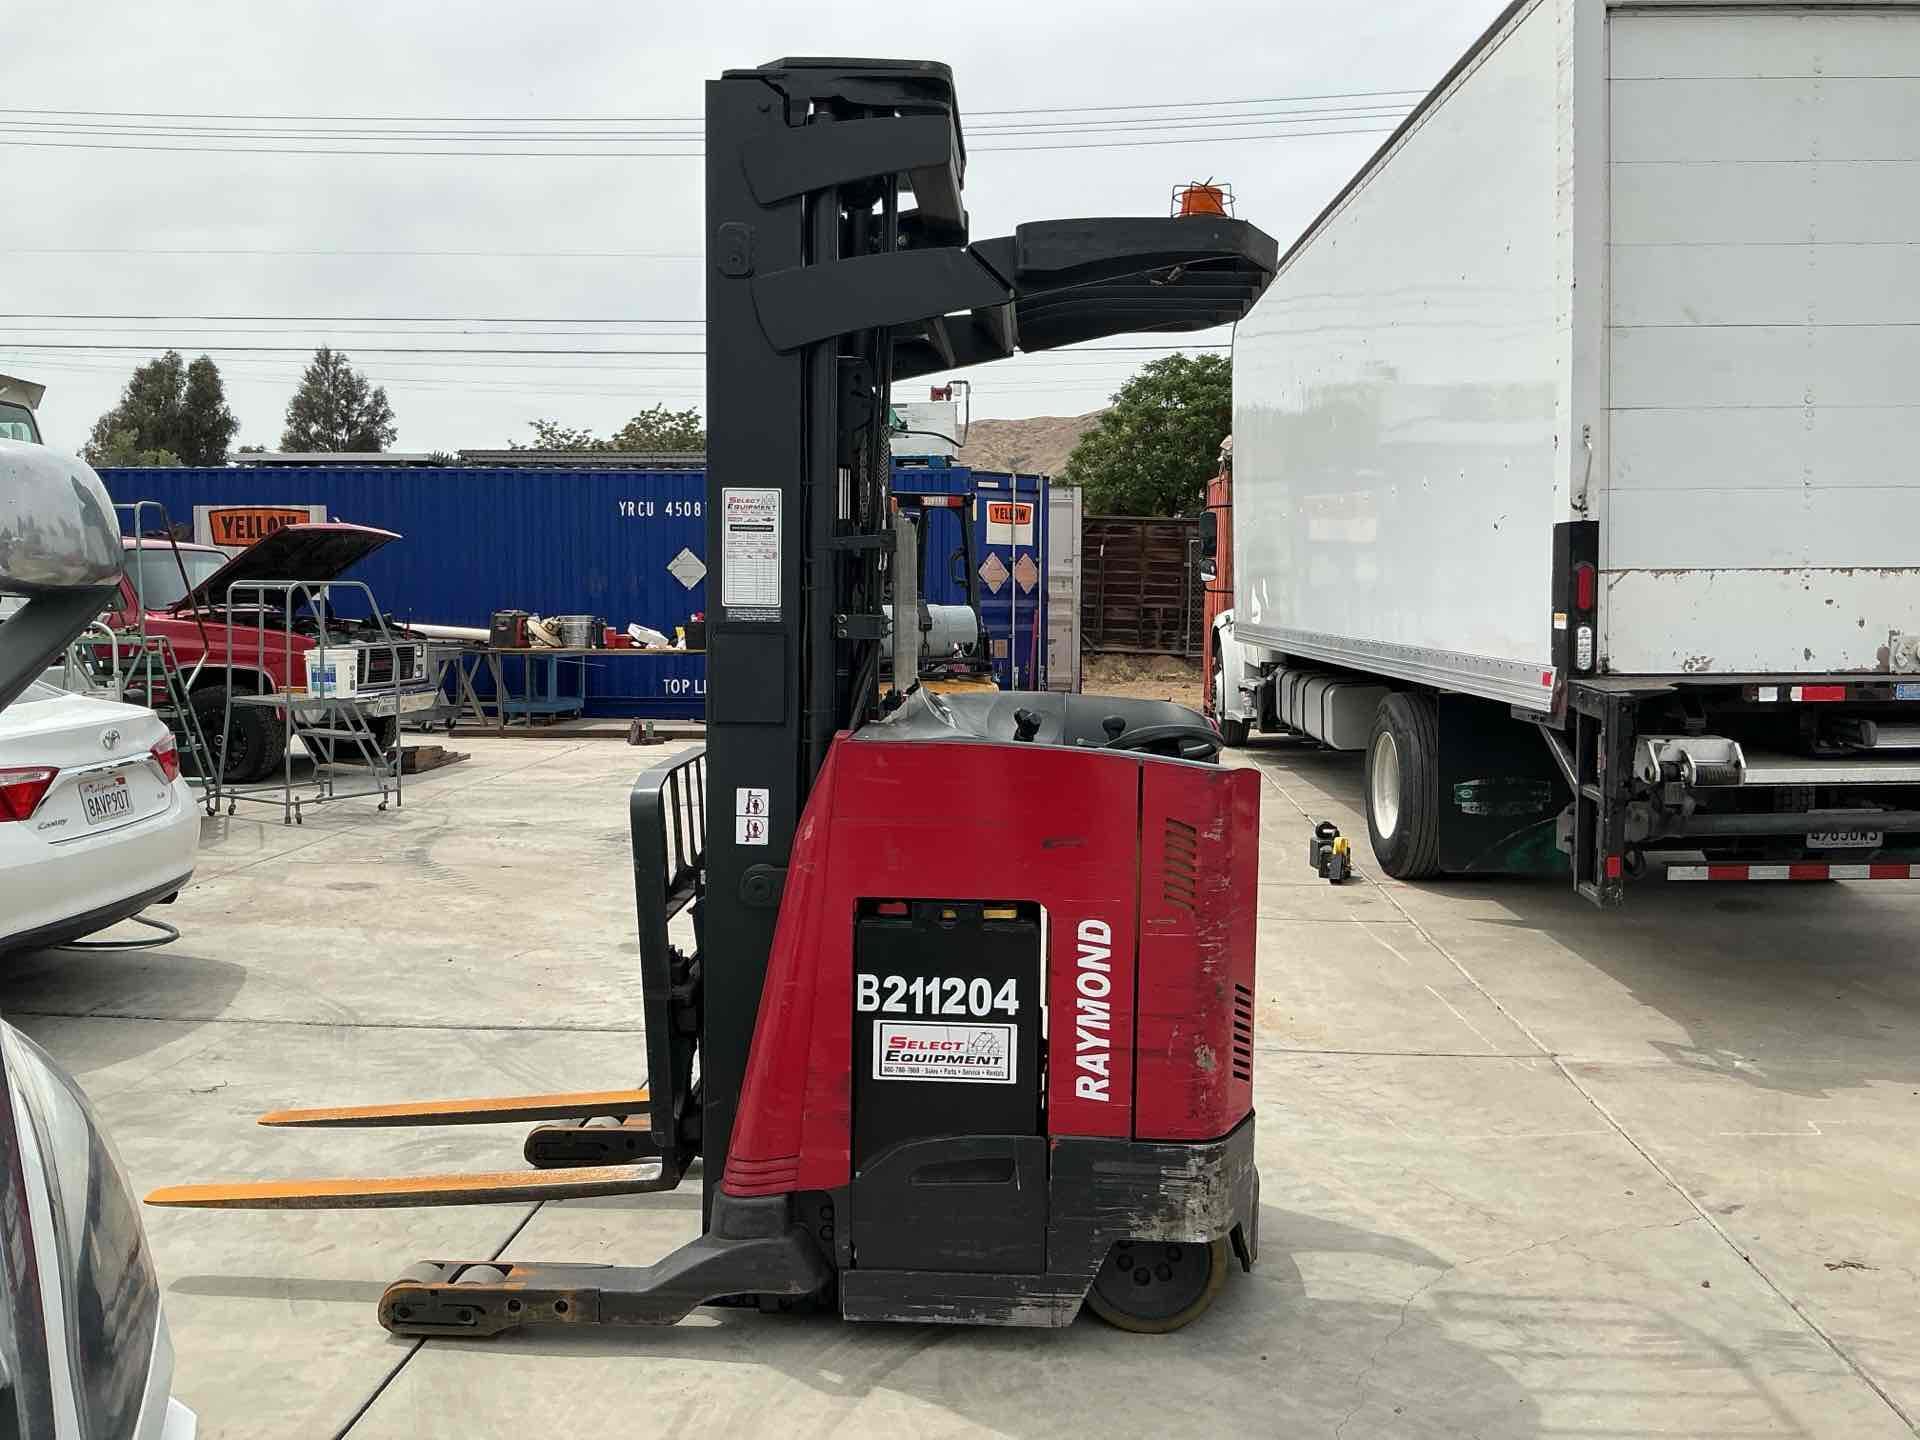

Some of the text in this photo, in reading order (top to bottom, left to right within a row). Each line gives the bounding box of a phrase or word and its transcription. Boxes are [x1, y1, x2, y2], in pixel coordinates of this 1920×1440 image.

[619, 501, 708, 517] YRCU 4508
[663, 679, 690, 694] TOP
[87, 789, 129, 817] 8AVP907
[857, 973, 1020, 1016] B211204
[1076, 919, 1112, 1101] RAYMOND
[888, 1036, 965, 1050] SELECT
[885, 1050, 1003, 1065] EQUIPMENT
